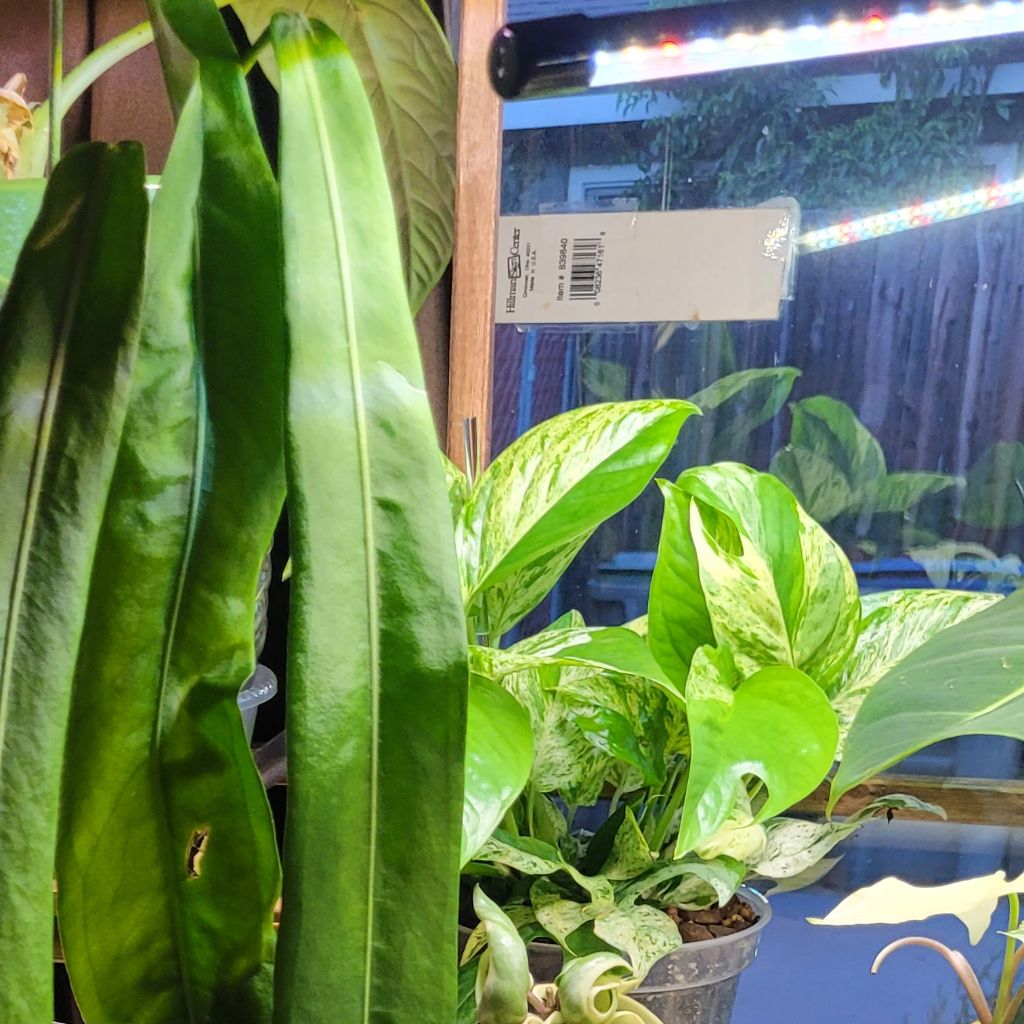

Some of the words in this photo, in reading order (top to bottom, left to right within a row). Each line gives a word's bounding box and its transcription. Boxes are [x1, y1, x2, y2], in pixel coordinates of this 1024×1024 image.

[510, 227, 520, 255] Center
[506, 278, 517, 313] Hillman
[556, 282, 565, 300] Item
